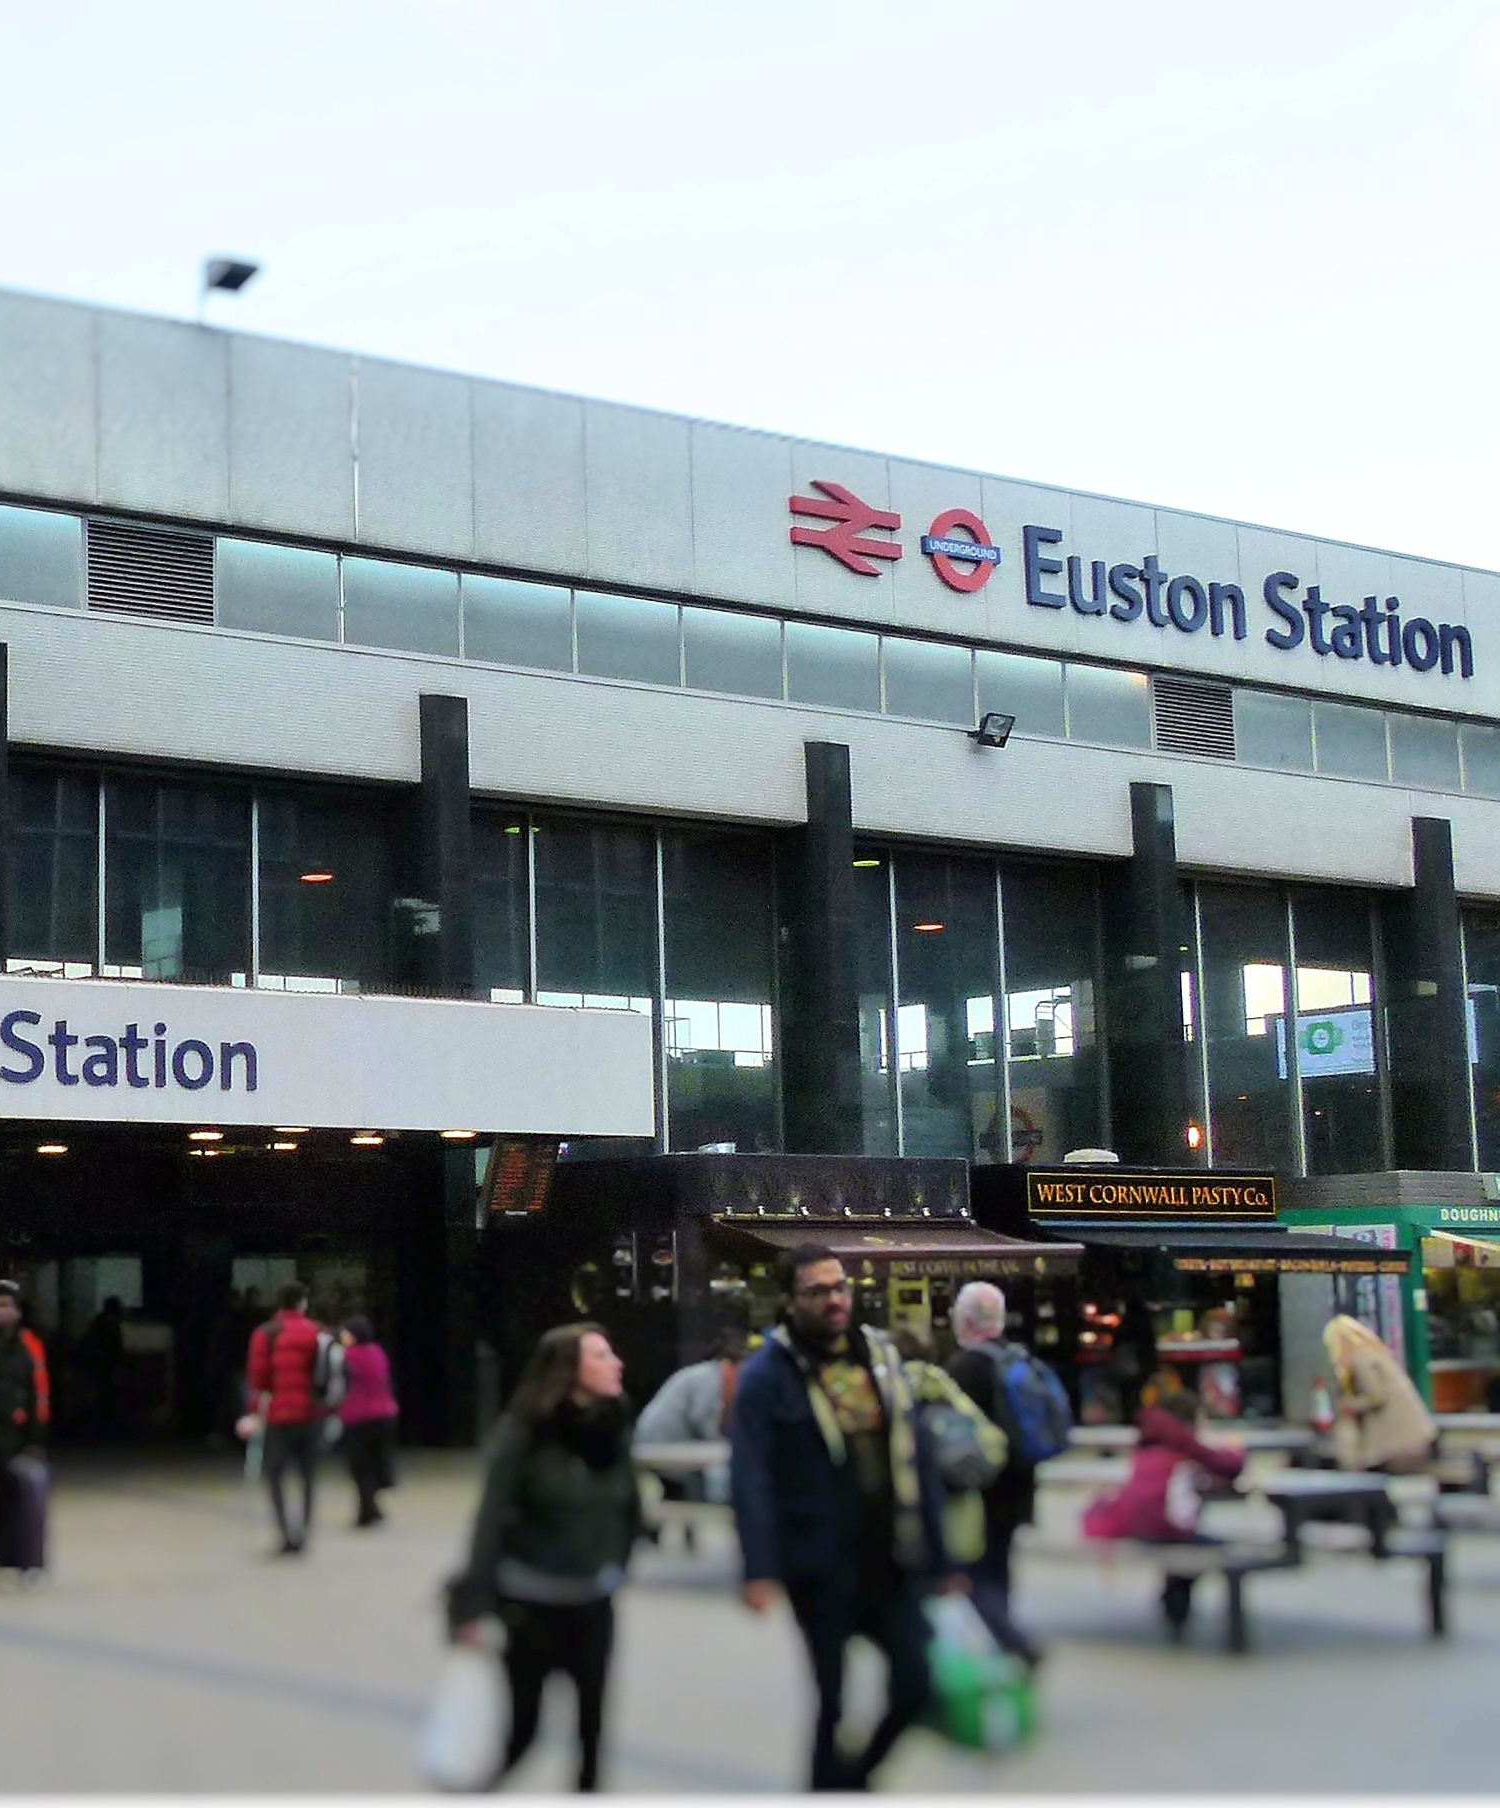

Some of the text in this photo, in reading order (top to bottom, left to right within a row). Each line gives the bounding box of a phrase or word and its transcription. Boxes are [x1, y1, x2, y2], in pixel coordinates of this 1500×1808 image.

[929, 540, 997, 560] UNDERGROUND
[1023, 524, 1474, 680] Euston Station
[1036, 1183, 1086, 1204] WEST
[1089, 1184, 1189, 1206] CORNWALL
[1191, 1186, 1242, 1206] PASTY
